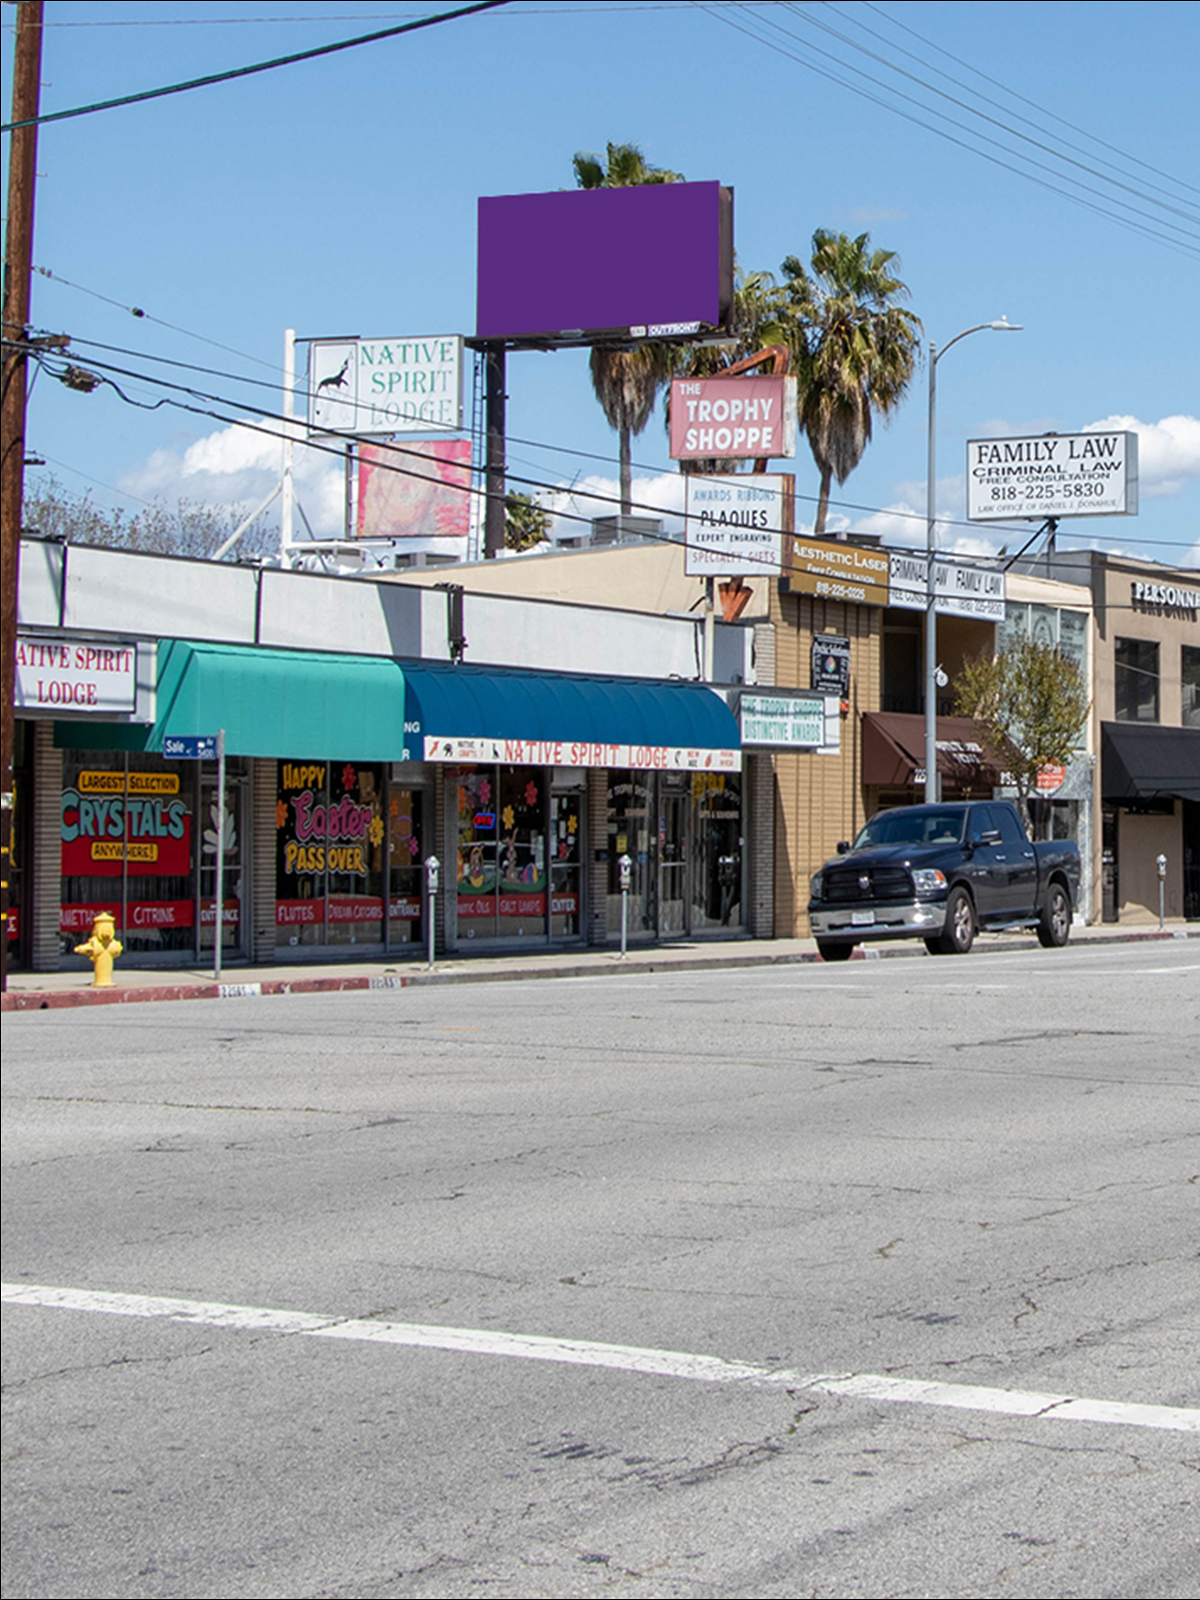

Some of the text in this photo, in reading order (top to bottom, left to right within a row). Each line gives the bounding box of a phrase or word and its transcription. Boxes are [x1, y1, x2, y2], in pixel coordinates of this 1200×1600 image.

[360, 340, 454, 366] NATIVE
[371, 370, 452, 394] SPIRIT
[679, 383, 701, 395] THE
[370, 400, 452, 426] LODGE
[686, 398, 773, 423] TROPHY
[685, 426, 773, 451] SHOPPE
[977, 437, 1118, 464] FAMILY LAW
[972, 461, 1123, 478] CRIMINAL LAW
[979, 473, 1110, 485] FREE CONSULTATION
[693, 489, 776, 502] AWARDS RIBBONS
[991, 483, 1104, 501] 818-225-5830
[978, 505, 995, 513] LAW
[996, 504, 1023, 512] OFFICE
[1026, 503, 1037, 511] OF
[1039, 502, 1067, 510] DANIEL
[700, 510, 768, 527] PLAQUES
[696, 533, 772, 543] EXPERT ENGRAVING
[692, 551, 776, 564] SPECIALTY GIFTS
[854, 552, 888, 572] LASER
[935, 567, 949, 586] AW
[956, 569, 981, 592] FAMILY
[985, 574, 1001, 594] LAW
[1135, 582, 1200, 608] PERSONNE
[15, 643, 133, 673] ATIVE SPIRIT
[38, 680, 98, 706] LODGE
[403, 721, 420, 733] NG
[166, 740, 185, 753] Sale
[504, 739, 668, 768] NATIVE SPIRIT LODGE
[82, 775, 177, 790] LARGEST SELECTION
[283, 764, 325, 790] HAPPY
[60, 792, 186, 842] CRYSTALS
[291, 791, 372, 839] Easter
[473, 814, 494, 827] OPEN
[278, 905, 314, 921] FLUTES
[552, 899, 575, 912] ENTER
[133, 906, 175, 924] CITRINE
